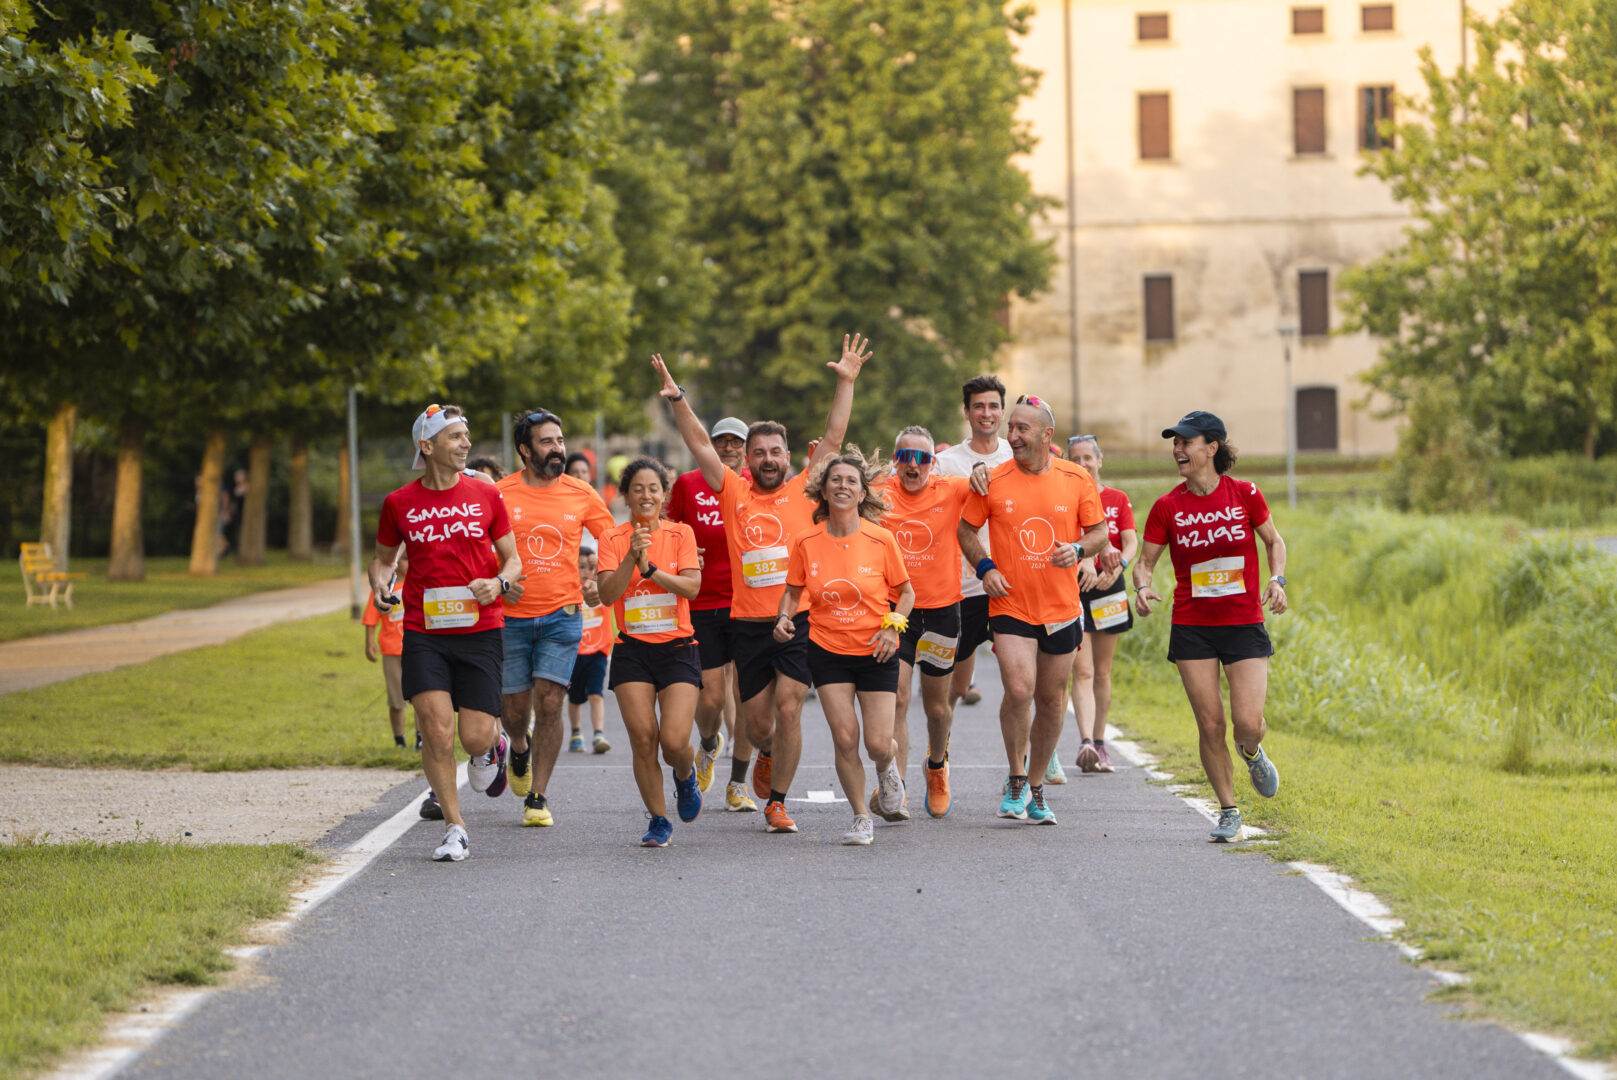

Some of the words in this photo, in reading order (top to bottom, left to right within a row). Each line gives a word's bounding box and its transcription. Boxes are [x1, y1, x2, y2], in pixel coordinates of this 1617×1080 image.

[408, 520, 484, 543] 42,195
[1176, 524, 1246, 548] 42,195
[755, 561, 777, 574] 382
[1208, 572, 1230, 584] 321
[437, 600, 465, 613] 550
[640, 608, 662, 620] 381
